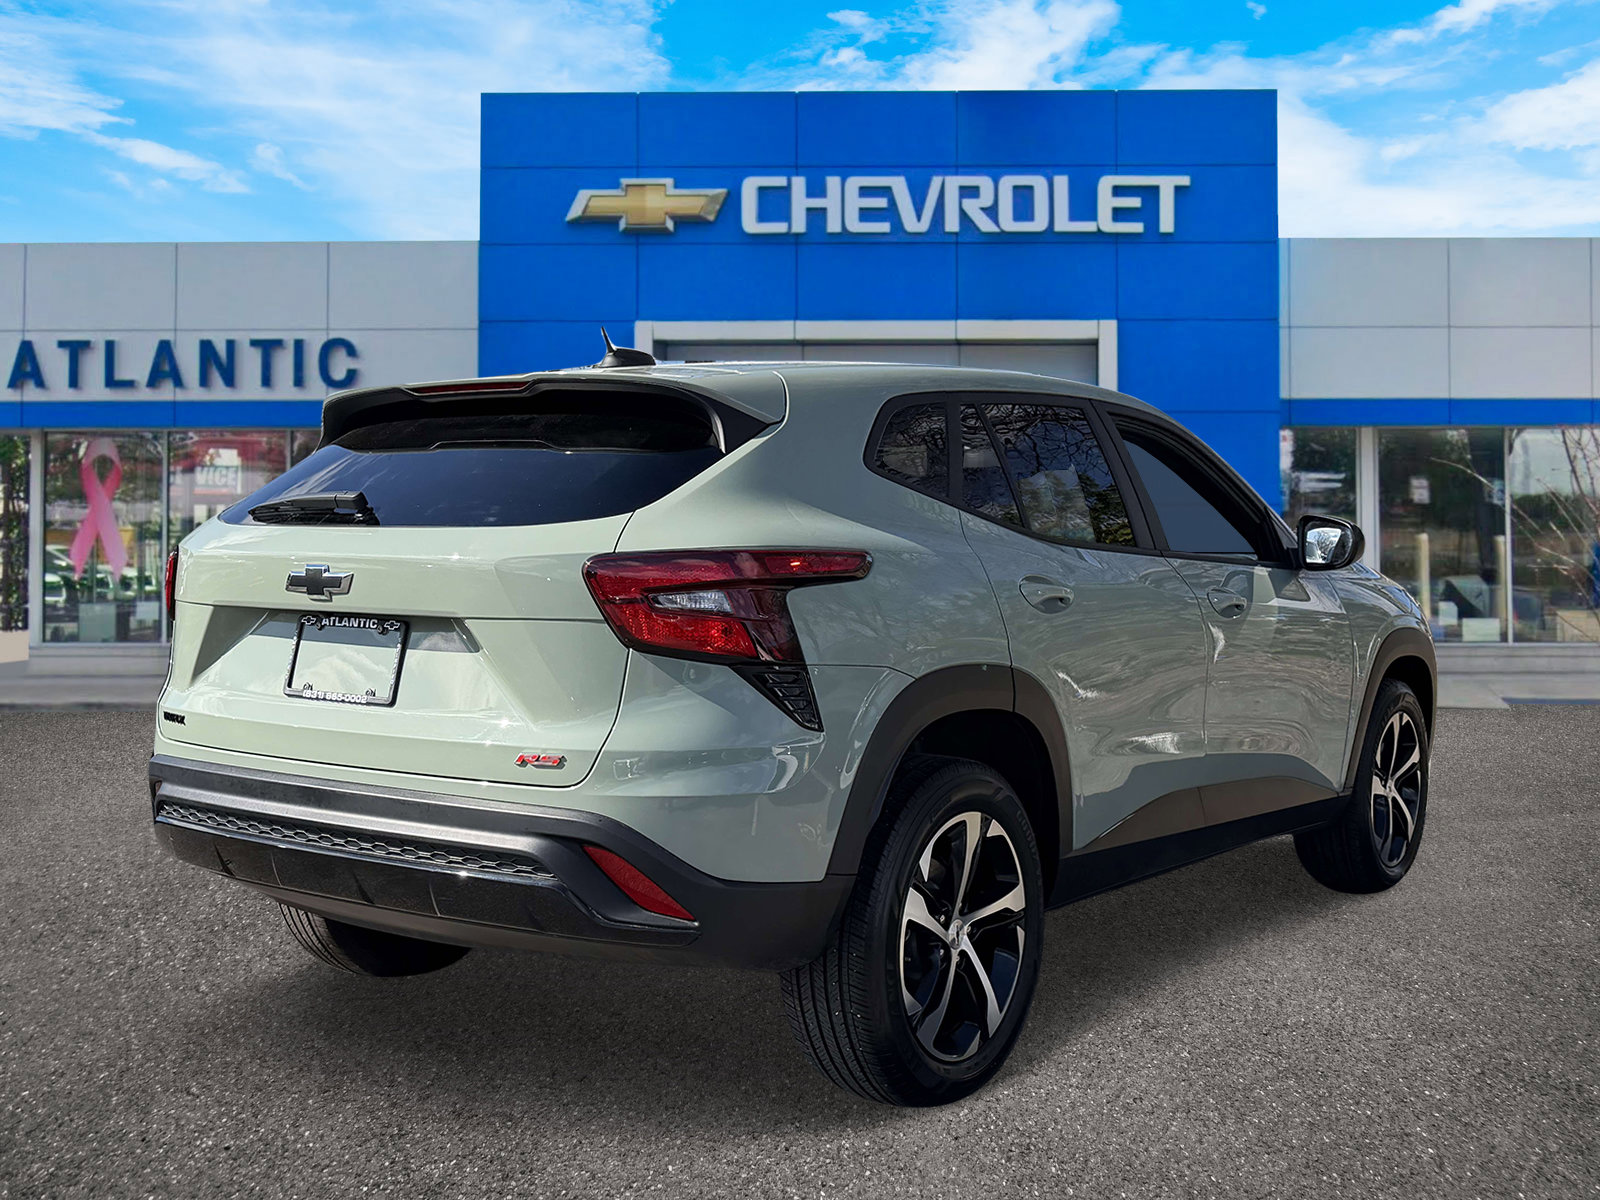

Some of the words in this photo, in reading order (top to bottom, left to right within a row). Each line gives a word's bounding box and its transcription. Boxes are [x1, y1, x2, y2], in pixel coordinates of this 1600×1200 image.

[741, 175, 1191, 234] CHEVROLET
[7, 337, 361, 390] ATLANTIC
[321, 616, 378, 629] ATLANTIC
[514, 752, 568, 770] RS
